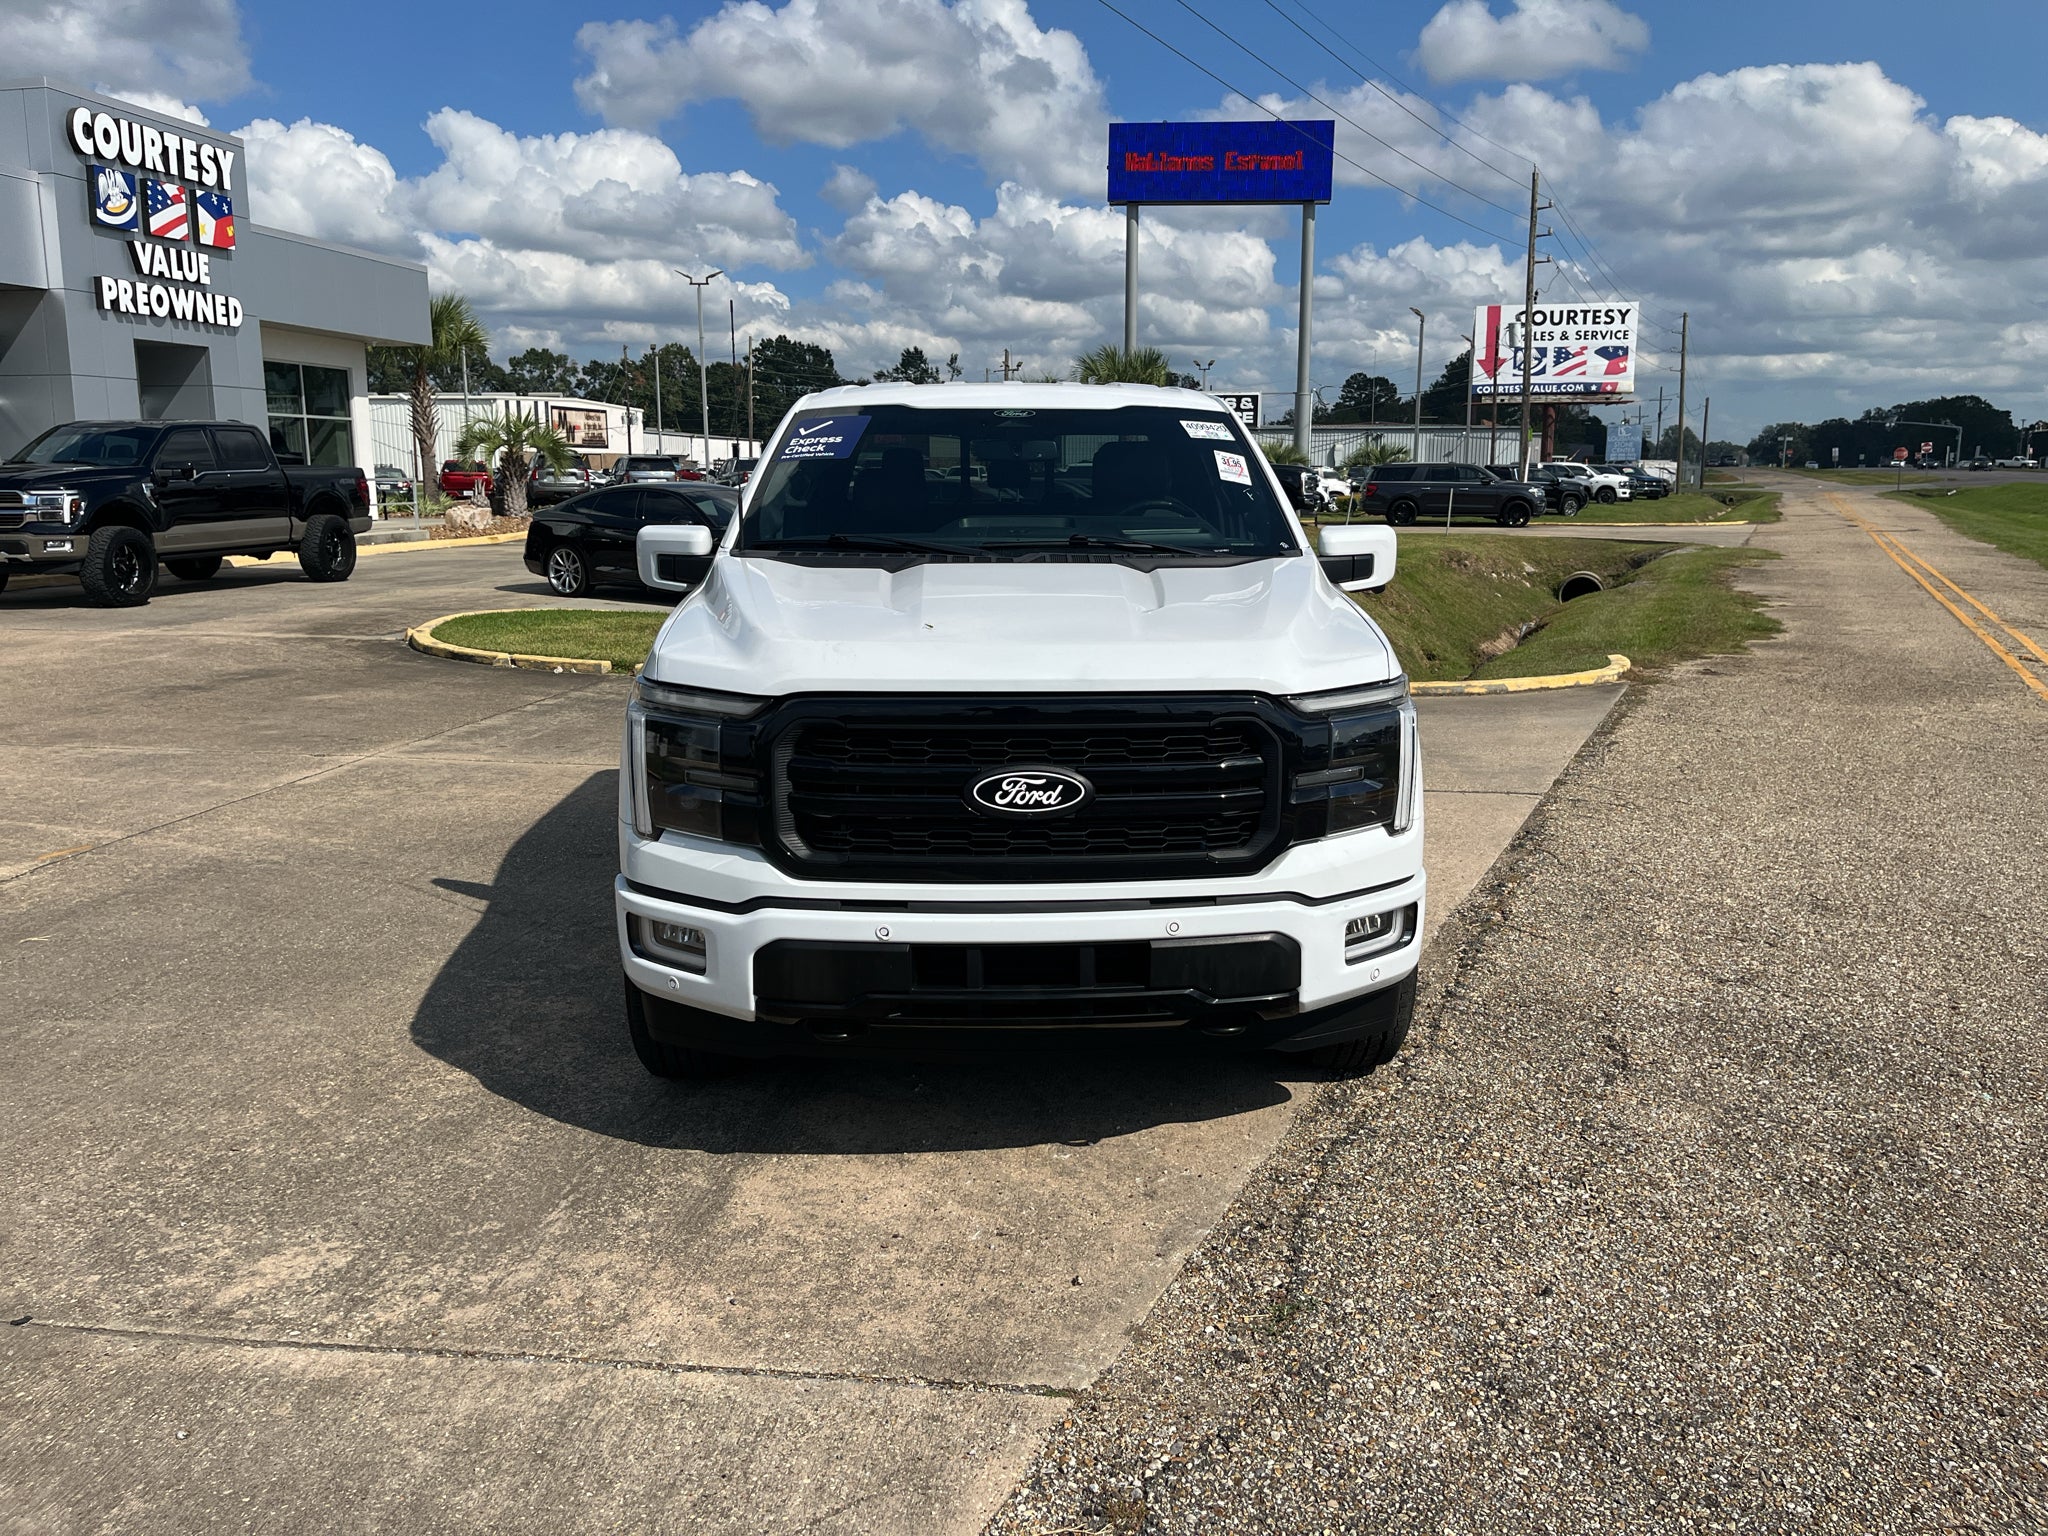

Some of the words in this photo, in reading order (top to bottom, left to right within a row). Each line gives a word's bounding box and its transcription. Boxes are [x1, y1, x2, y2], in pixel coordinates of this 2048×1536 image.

[70, 107, 235, 190] COURTESY
[133, 240, 211, 285] VALUE
[101, 275, 243, 328] PREOWNED
[1521, 330, 1554, 342] LES
[1560, 330, 1570, 341] &
[1575, 329, 1629, 341] SERVICE
[1476, 384, 1584, 395] COURTESVALUE.COM
[1240, 397, 1254, 409] &
[1186, 423, 1227, 433] 4099420
[789, 436, 843, 446] Express
[785, 443, 826, 454] Check
[994, 777, 1064, 805] Ford
